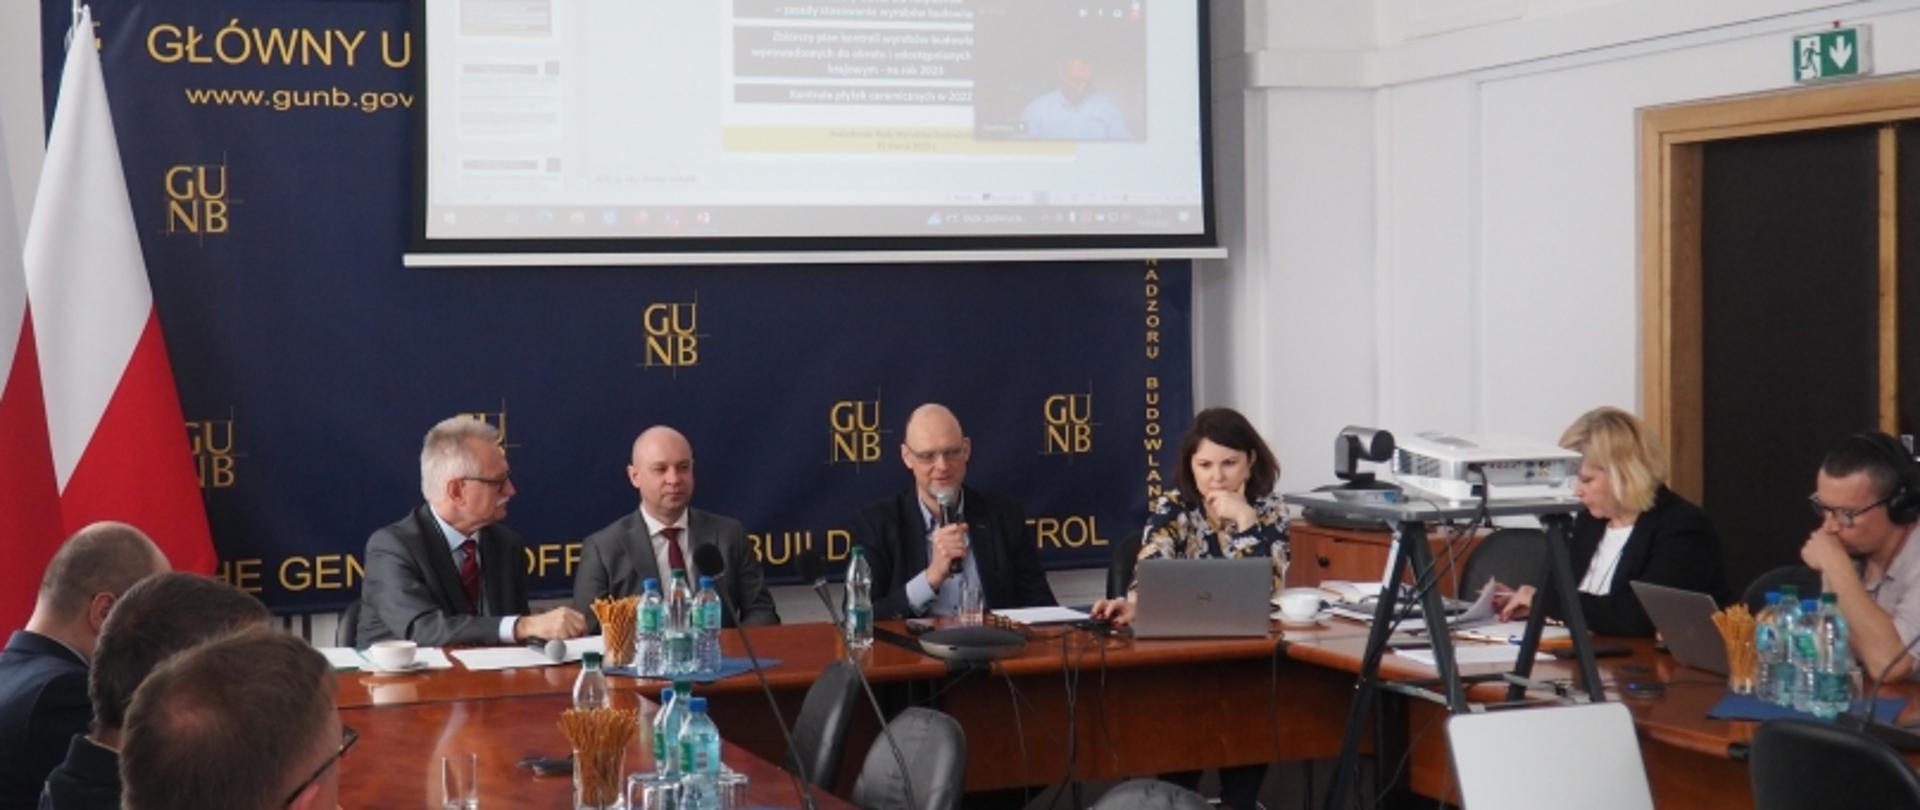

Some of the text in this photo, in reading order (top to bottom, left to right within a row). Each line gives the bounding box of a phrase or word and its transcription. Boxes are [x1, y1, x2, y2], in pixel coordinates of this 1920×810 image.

[147, 18, 366, 67] GŁÓWNY
[382, 31, 412, 68] U
[816, 33, 839, 45] plan
[186, 87, 414, 113] www.gunb.gov
[165, 165, 226, 200] GU
[168, 200, 229, 233] NB
[644, 303, 696, 336] GU
[646, 335, 698, 366] NB
[830, 401, 880, 432] GU
[1044, 394, 1091, 424] GU
[834, 431, 881, 462] NB
[1047, 423, 1092, 453] NB
[1144, 376, 1163, 512] BUDOWLANE
[279, 554, 365, 591] GEN
